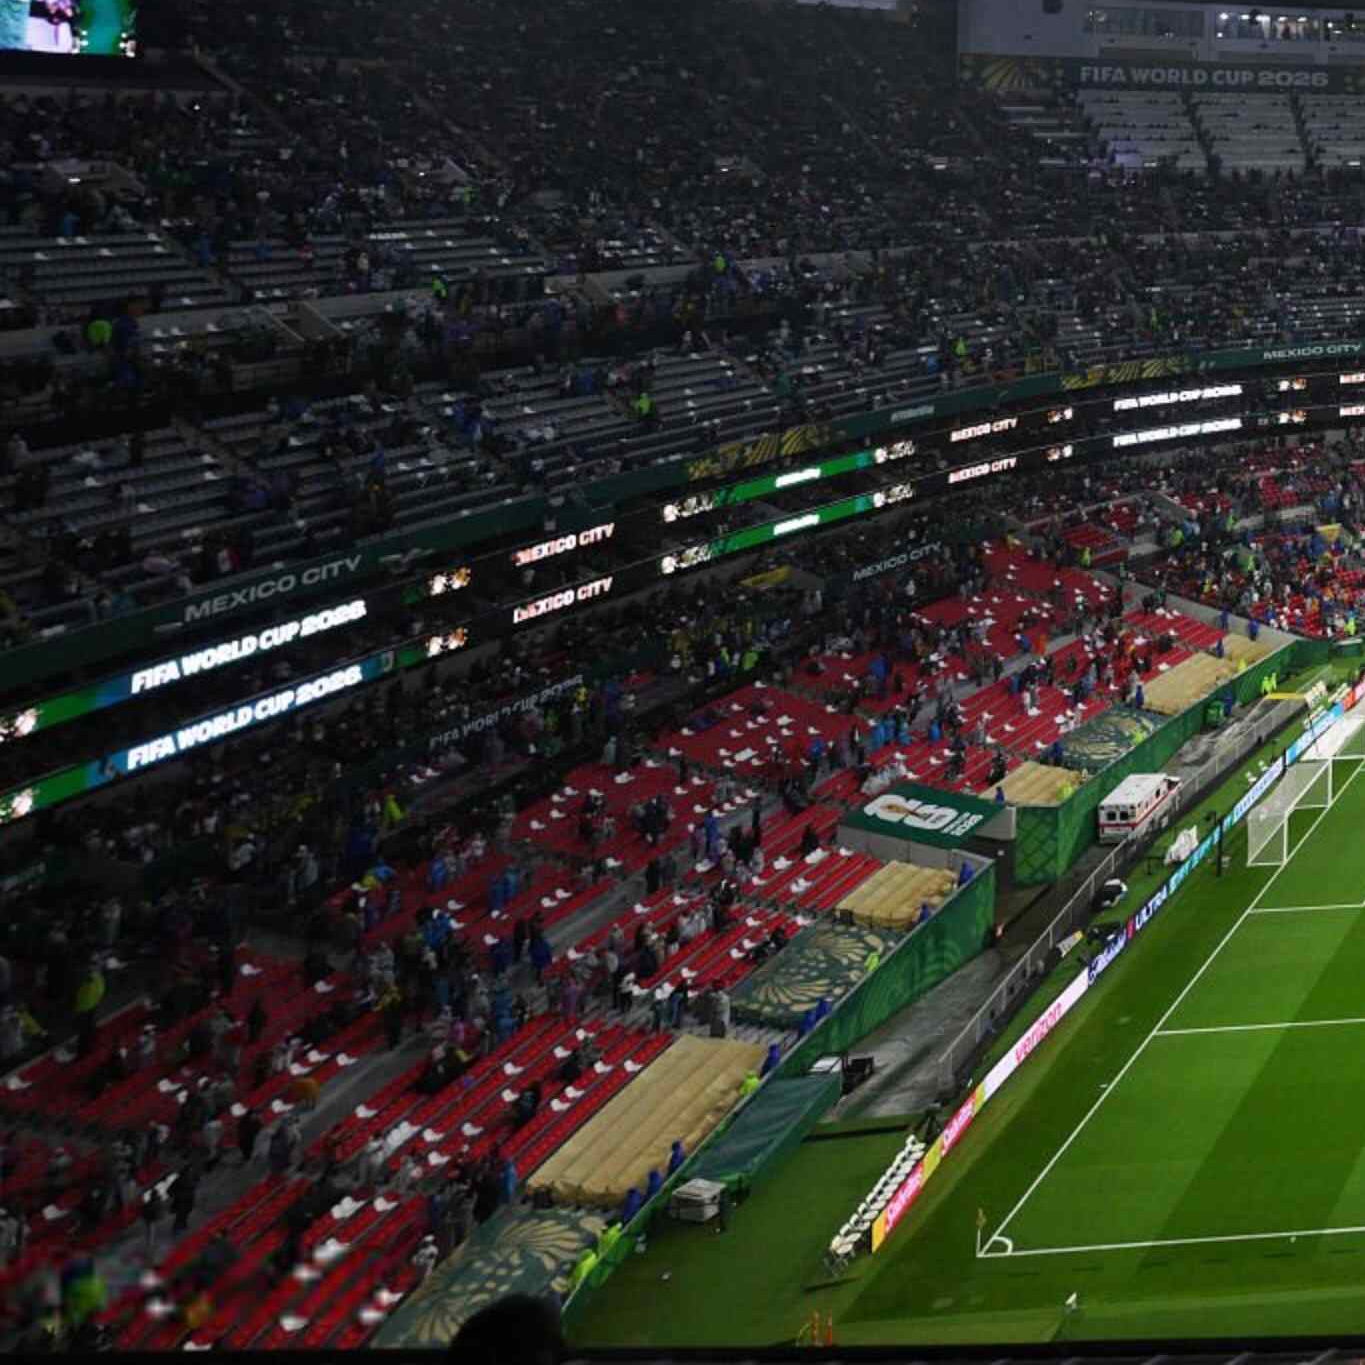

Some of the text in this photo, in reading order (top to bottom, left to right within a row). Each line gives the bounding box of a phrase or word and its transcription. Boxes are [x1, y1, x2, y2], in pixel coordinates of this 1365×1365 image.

[1080, 66, 1126, 83] FIFA
[1130, 68, 1207, 85] WORLD
[1212, 69, 1256, 85] CUP
[1263, 343, 1362, 360] MEXICO CITY
[991, 457, 1017, 472] CITY
[579, 522, 615, 546] CITY
[183, 554, 362, 622] MEXICO CITY
[577, 577, 614, 601] CITY
[130, 661, 182, 694] FIFA
[181, 635, 258, 676] WORLD
[258, 621, 300, 649] CUP
[126, 735, 177, 771] FIFA
[176, 705, 253, 752] WORLD
[253, 690, 295, 720] CUP
[1135, 884, 1169, 931] ULTRA
[1014, 1002, 1063, 1065] verizon
